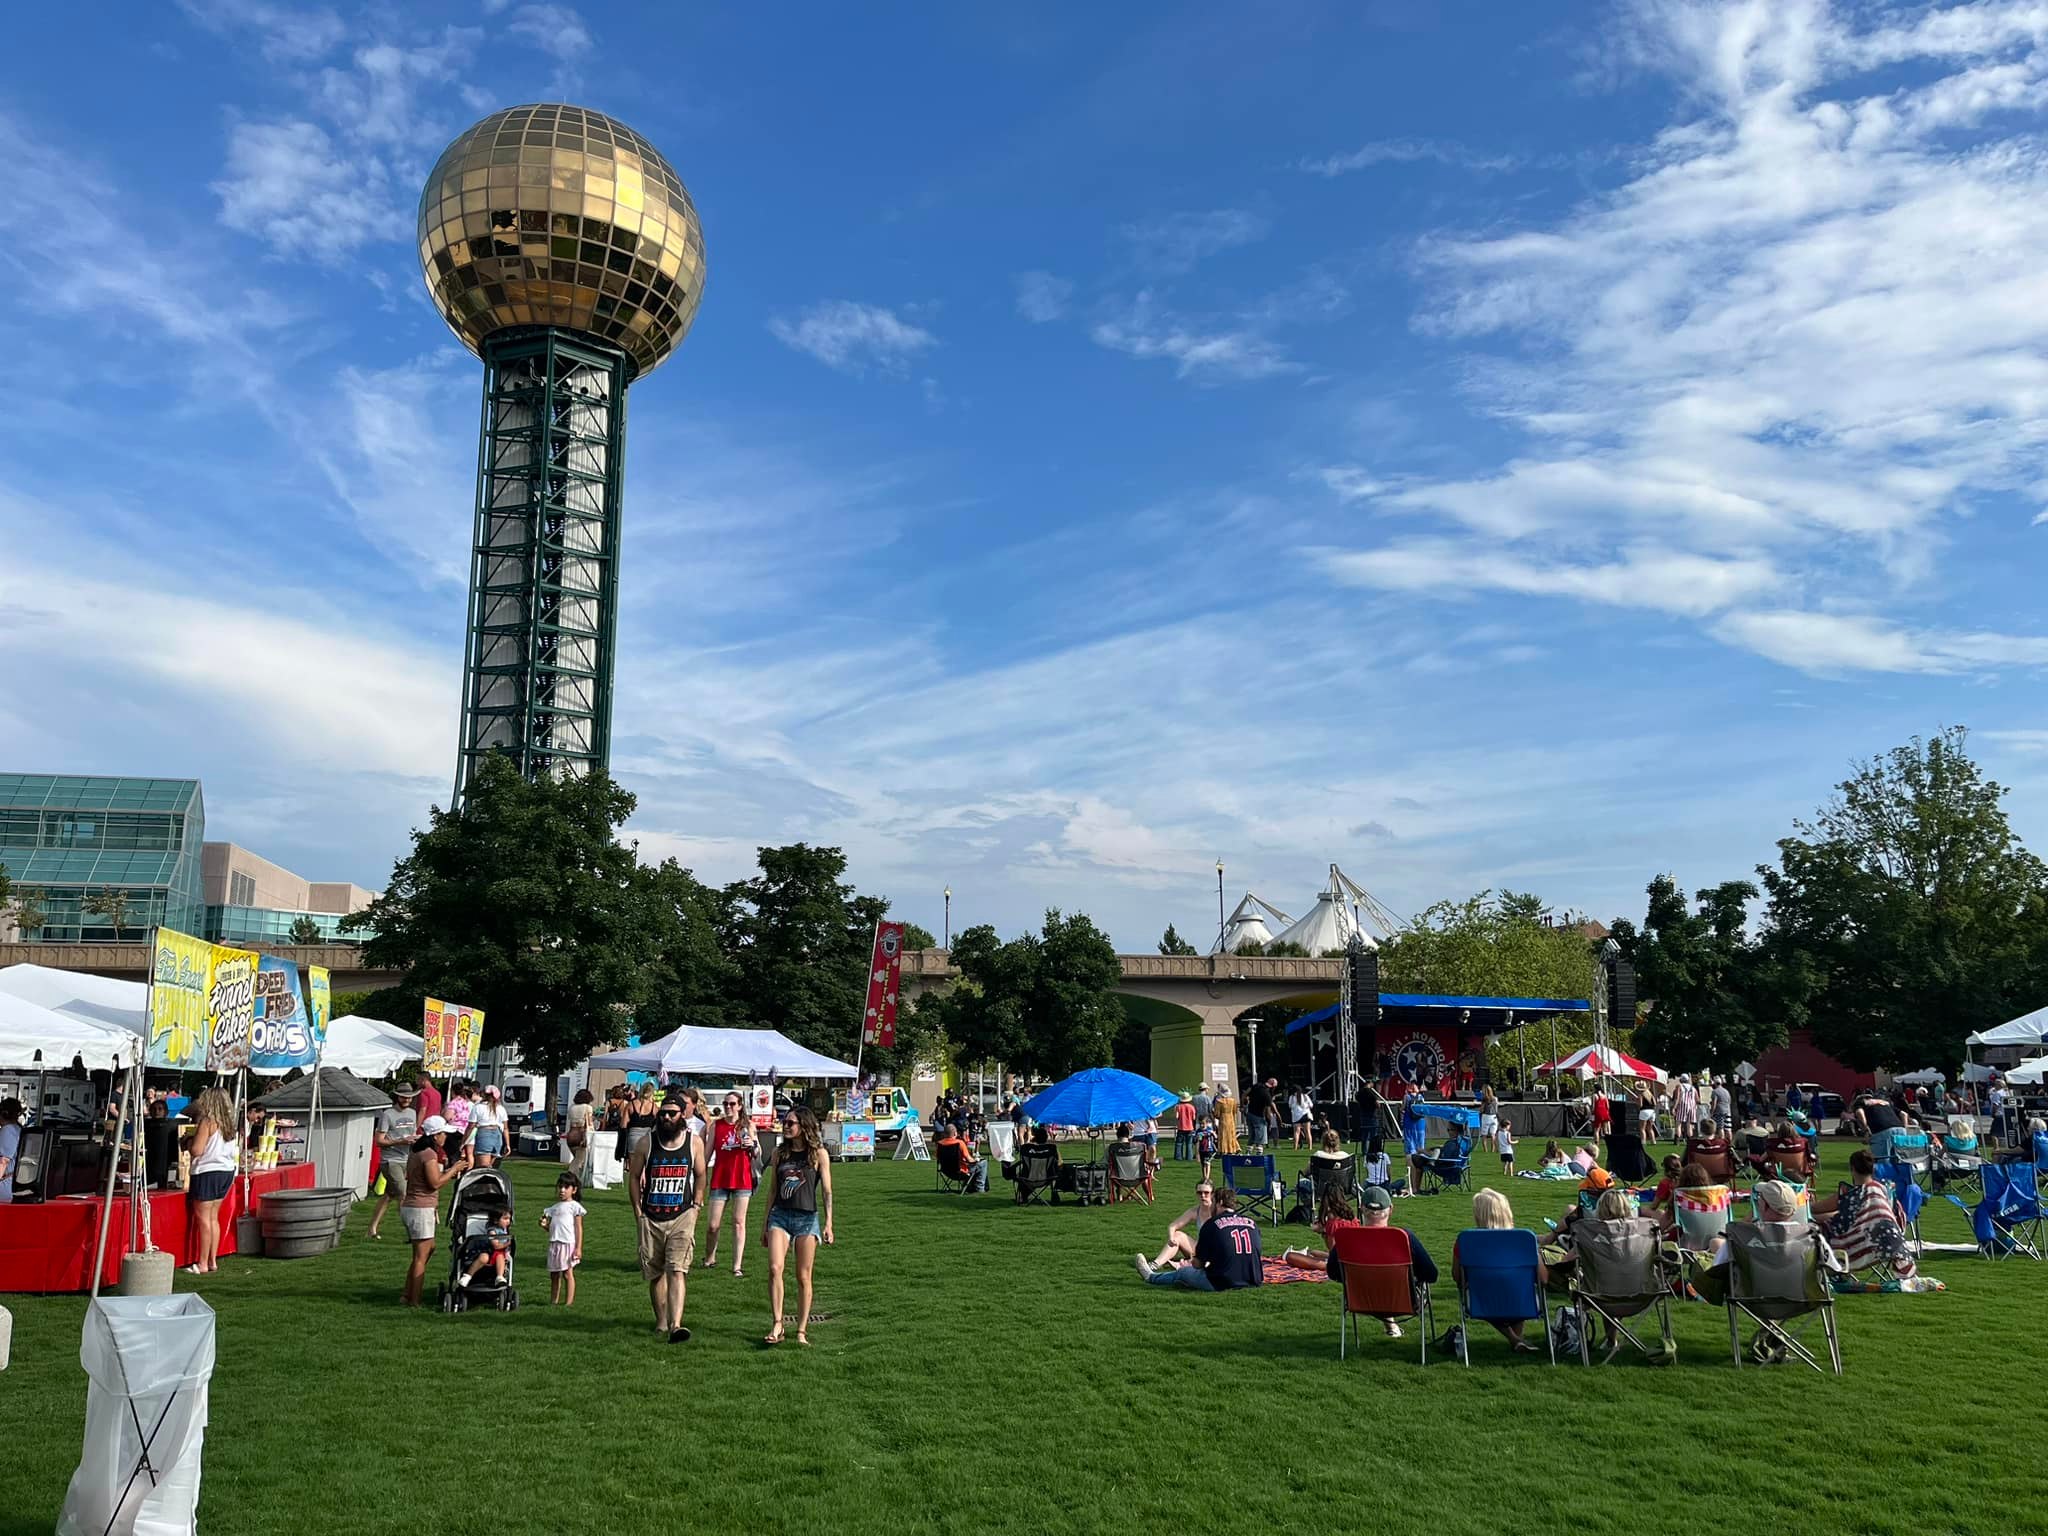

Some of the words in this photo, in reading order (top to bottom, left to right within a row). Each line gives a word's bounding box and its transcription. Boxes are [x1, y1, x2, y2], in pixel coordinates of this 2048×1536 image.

[209, 969, 256, 1017] Funnel
[256, 971, 286, 996] DEEP
[212, 1007, 252, 1048] Cakes
[251, 1018, 308, 1054] OREOS
[872, 1014, 884, 1046] CORN
[1230, 1228, 1252, 1254] 11
